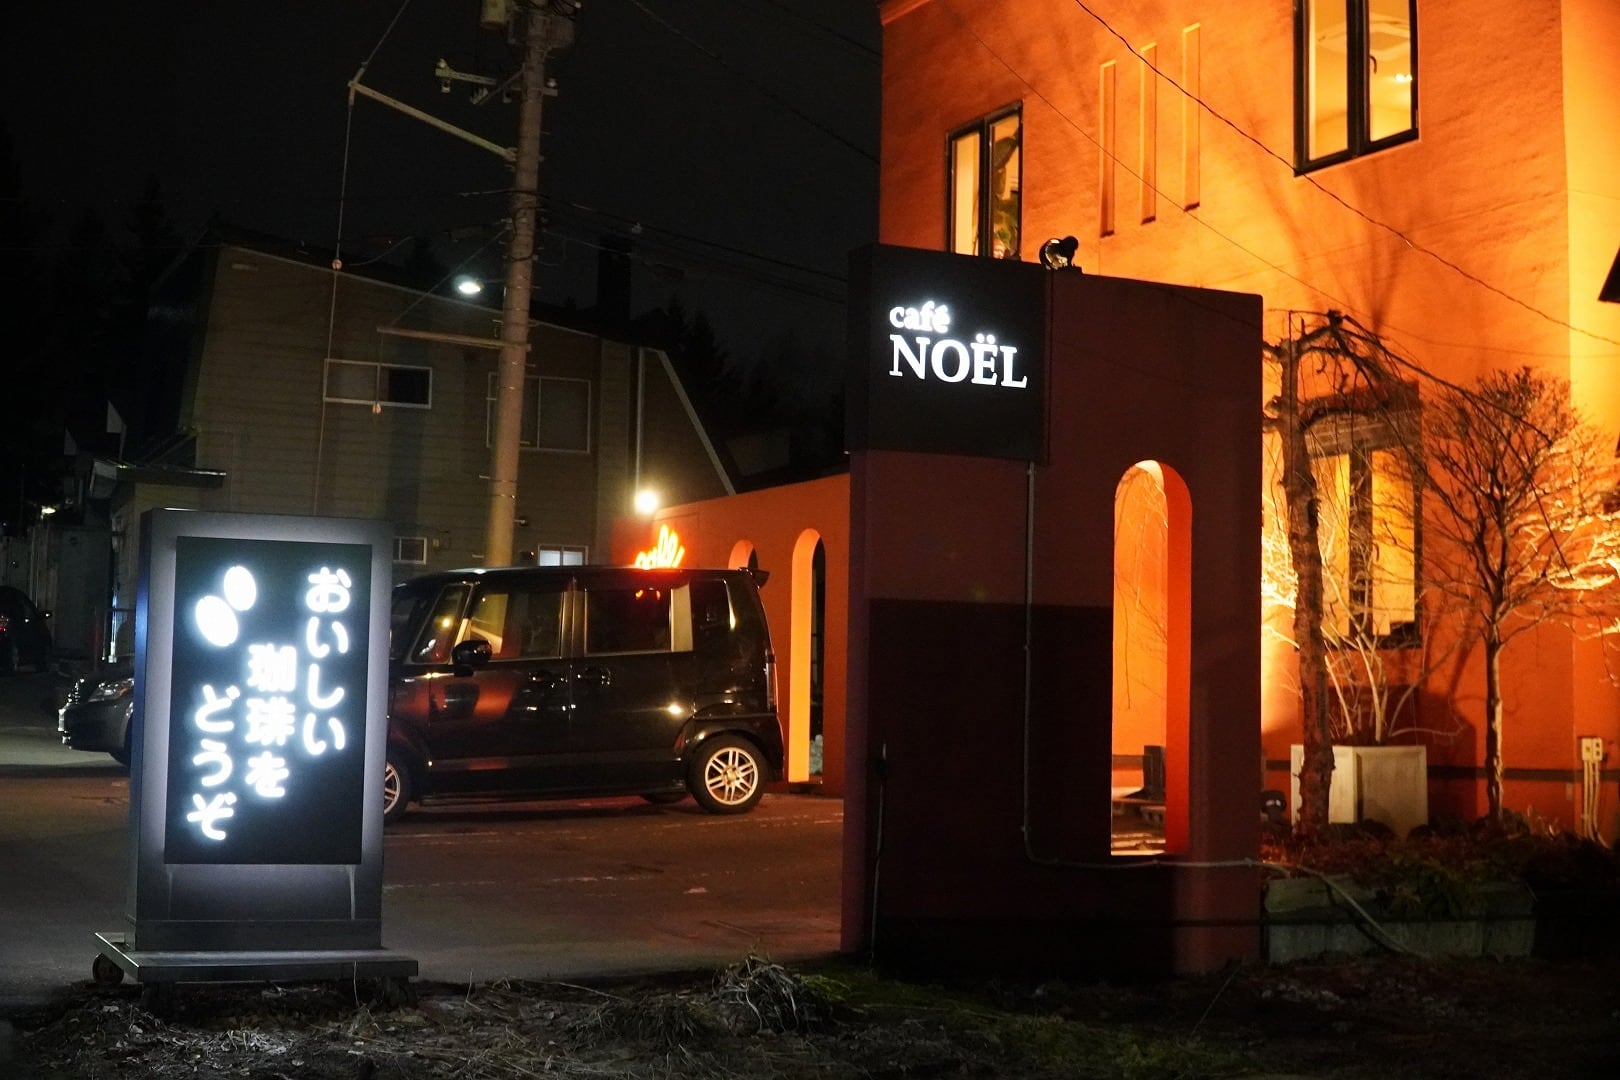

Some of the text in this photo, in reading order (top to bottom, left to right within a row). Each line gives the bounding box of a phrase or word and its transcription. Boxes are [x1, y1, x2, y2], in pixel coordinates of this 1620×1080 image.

[889, 300, 951, 334] café
[889, 333, 1028, 388] NOËL
[244, 643, 298, 798] 珈琲を
[303, 566, 352, 756] おいしい
[187, 684, 241, 841] どうぞ
